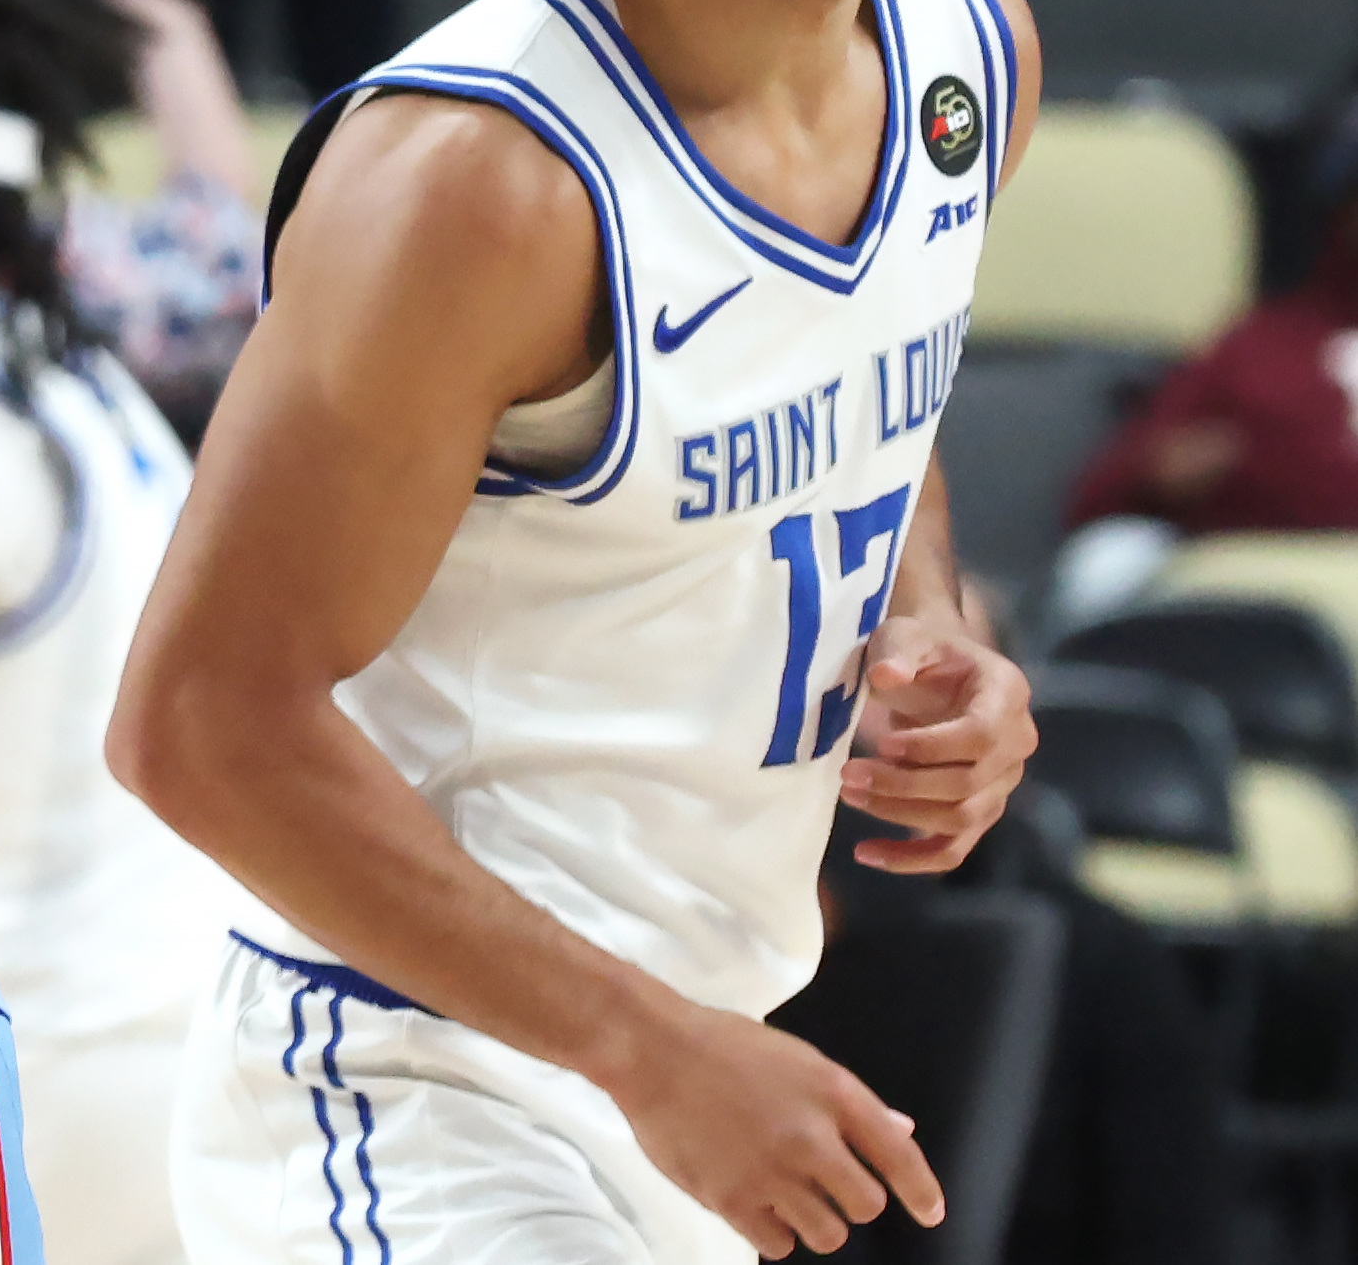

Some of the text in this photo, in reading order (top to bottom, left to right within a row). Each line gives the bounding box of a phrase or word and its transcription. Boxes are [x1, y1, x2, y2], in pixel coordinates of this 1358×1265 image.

[675, 307, 971, 521] SAINT LOUI
[759, 483, 912, 770] 13
